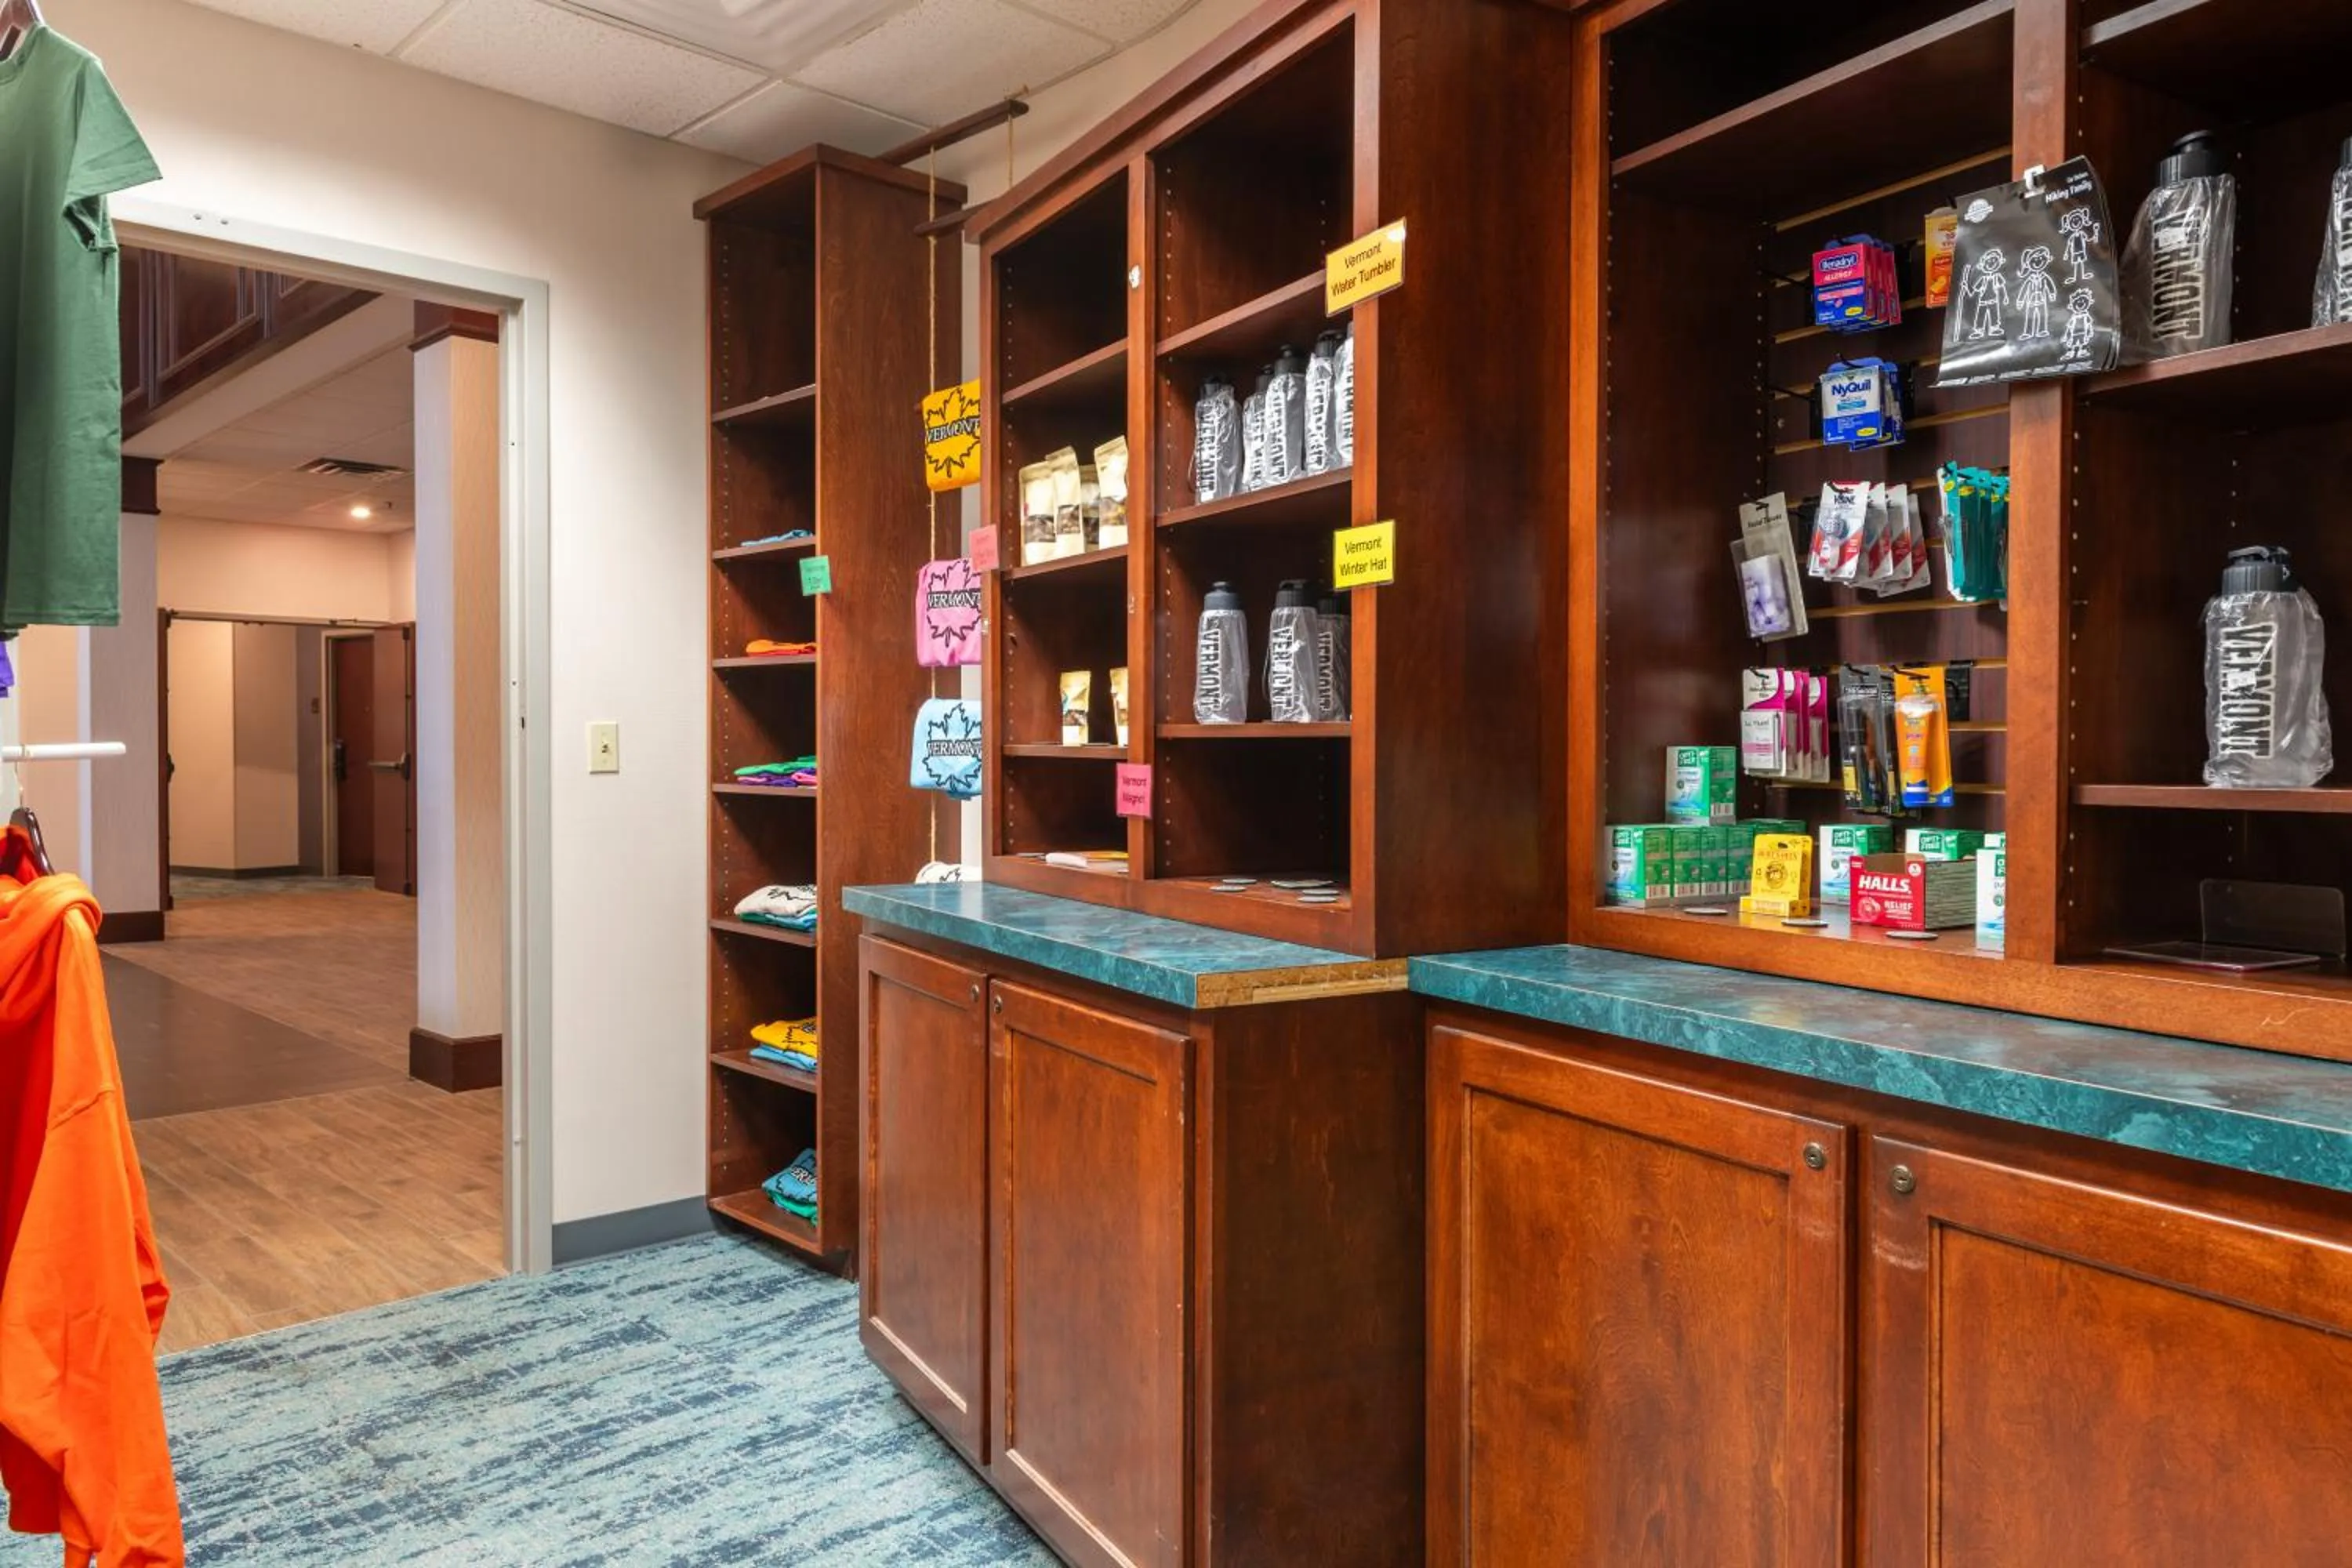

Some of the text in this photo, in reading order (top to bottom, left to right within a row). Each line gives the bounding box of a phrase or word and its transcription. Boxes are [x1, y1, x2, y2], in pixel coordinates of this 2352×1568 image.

[1344, 242, 1381, 268] Vermont
[1331, 257, 1396, 296] Water Tumbler
[1831, 379, 1871, 397] NyQuil
[1345, 537, 1382, 554] Vermont
[1338, 557, 1387, 576] Winter Hat
[1200, 629, 1221, 710] VERMONT
[2220, 623, 2277, 758] VERMONT
[1858, 874, 1911, 893] HALLS
[1884, 900, 1913, 910] RELIEF
